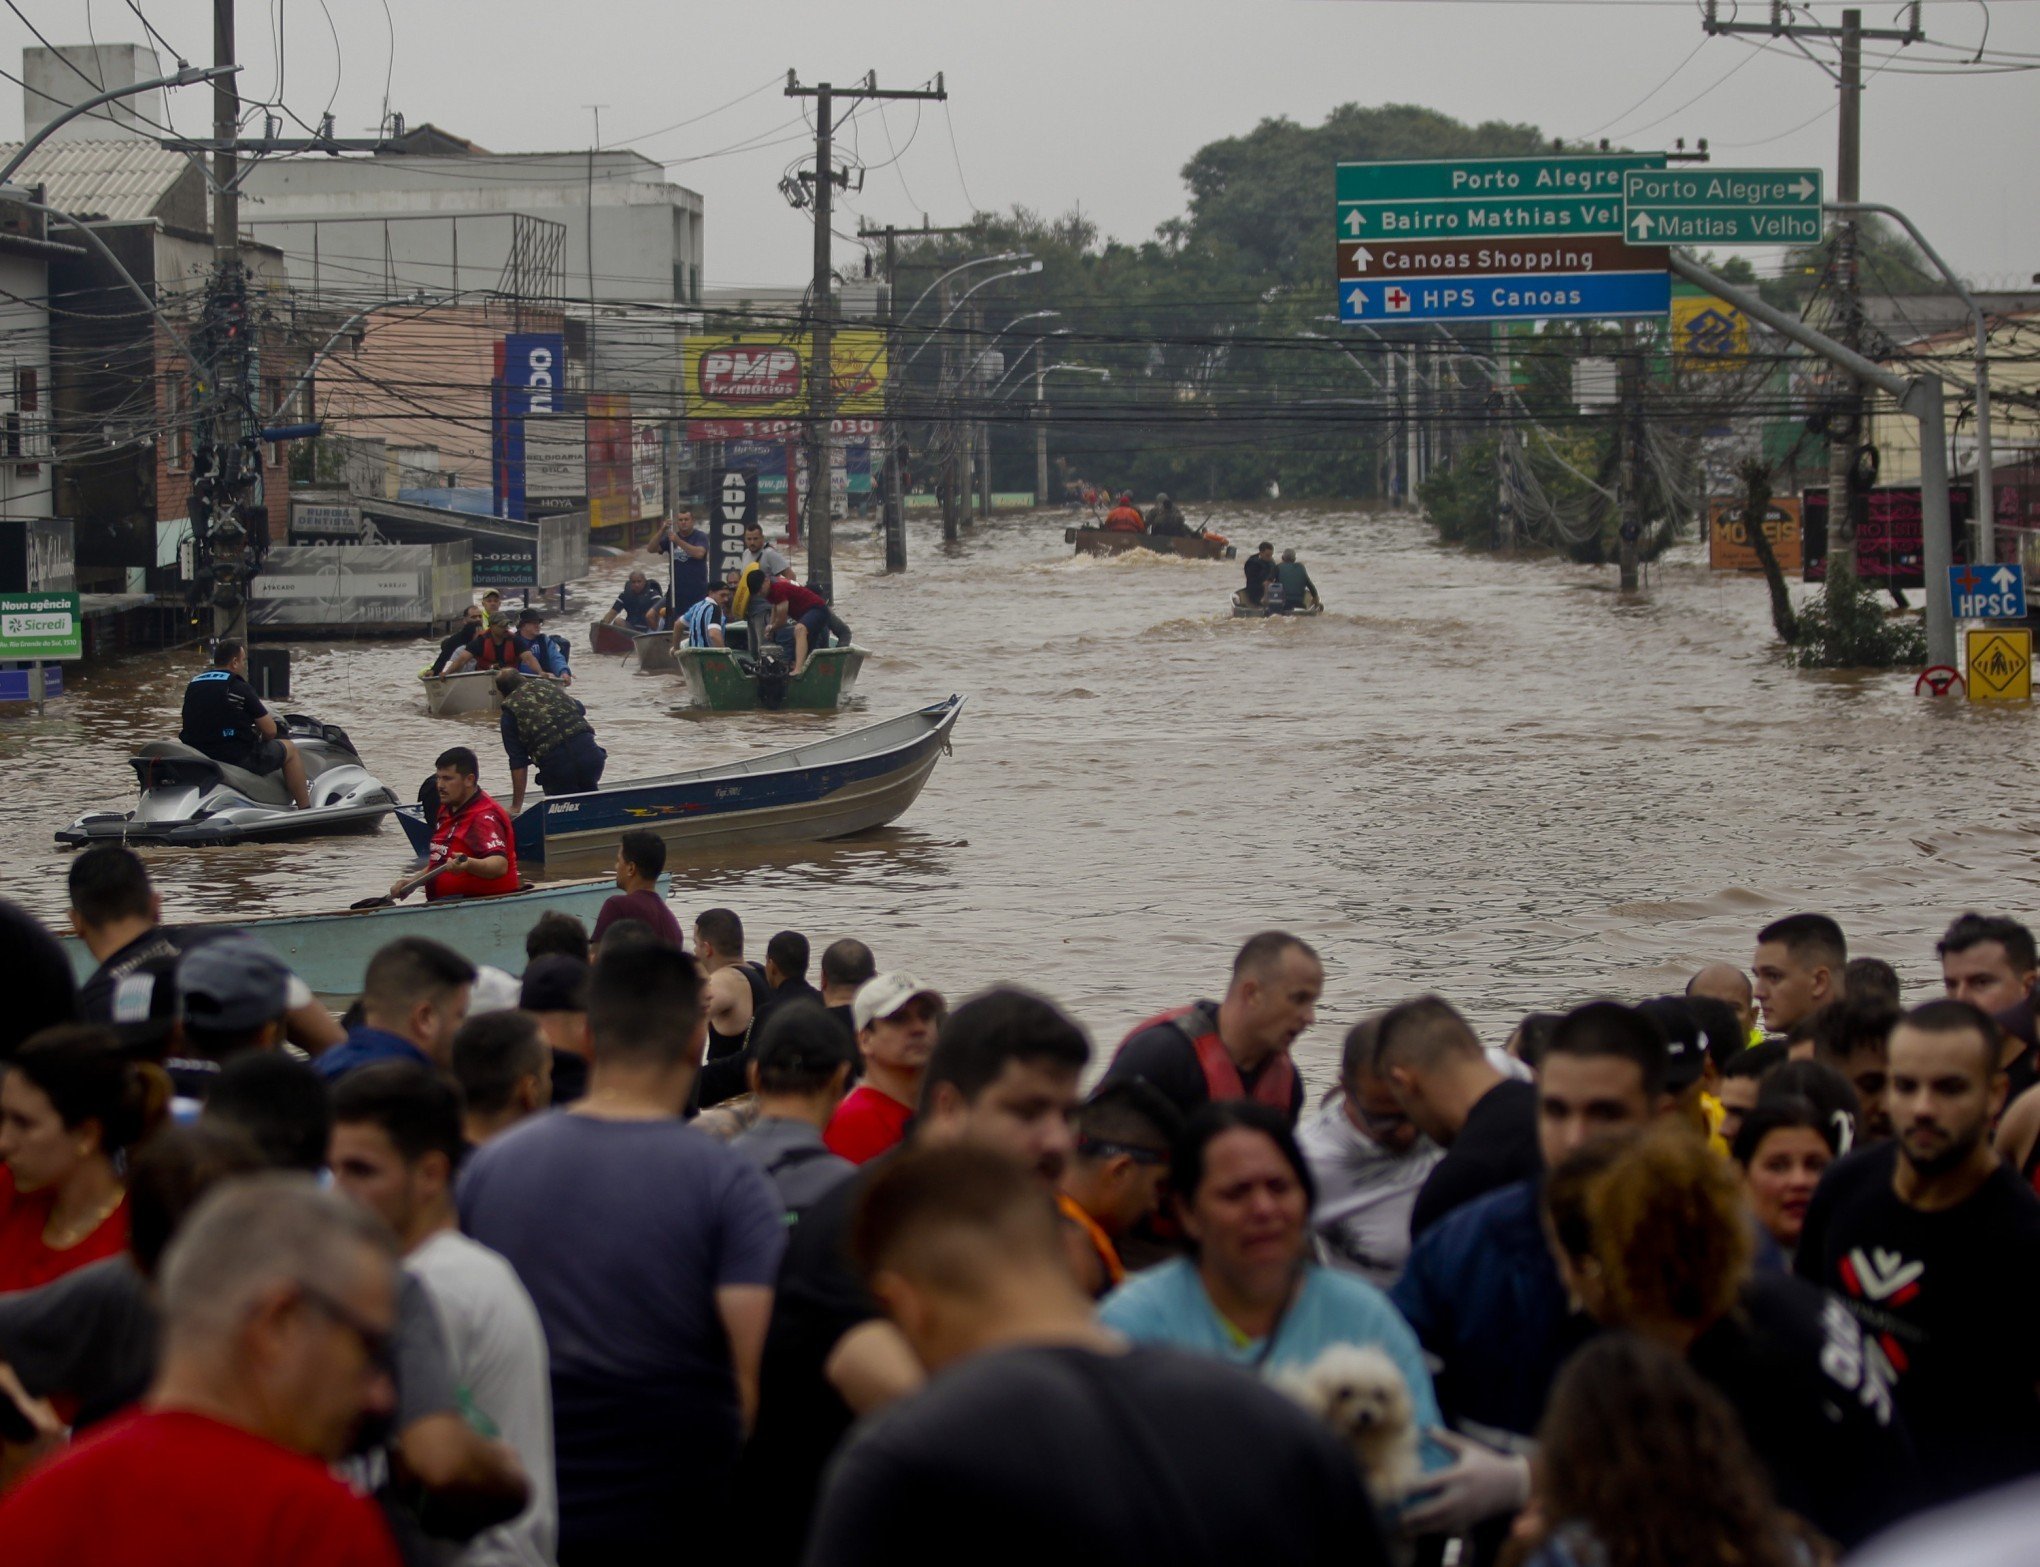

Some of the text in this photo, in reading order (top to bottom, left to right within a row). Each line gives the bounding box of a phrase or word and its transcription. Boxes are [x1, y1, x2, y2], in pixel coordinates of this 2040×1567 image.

[1452, 168, 1619, 191] Porto Alegre
[1629, 177, 1786, 203] Porto Alegre
[1382, 205, 1619, 231] Bairro Mathias Vel
[1658, 215, 1817, 236] Matias Velho
[1382, 249, 1594, 272] Canoas Shopping
[1423, 287, 1582, 309] HPS Canoas
[704, 352, 796, 382] PMP
[722, 473, 746, 583] ADVOGA
[1714, 522, 1798, 544] MOEIS
[473, 553, 533, 561] 3-0268
[474, 564, 533, 572] 1-4674
[1, 599, 72, 612] Nova agência
[1960, 593, 2018, 616] HPSC
[24, 618, 66, 631] Sicredi
[547, 802, 581, 815] Aluflex
